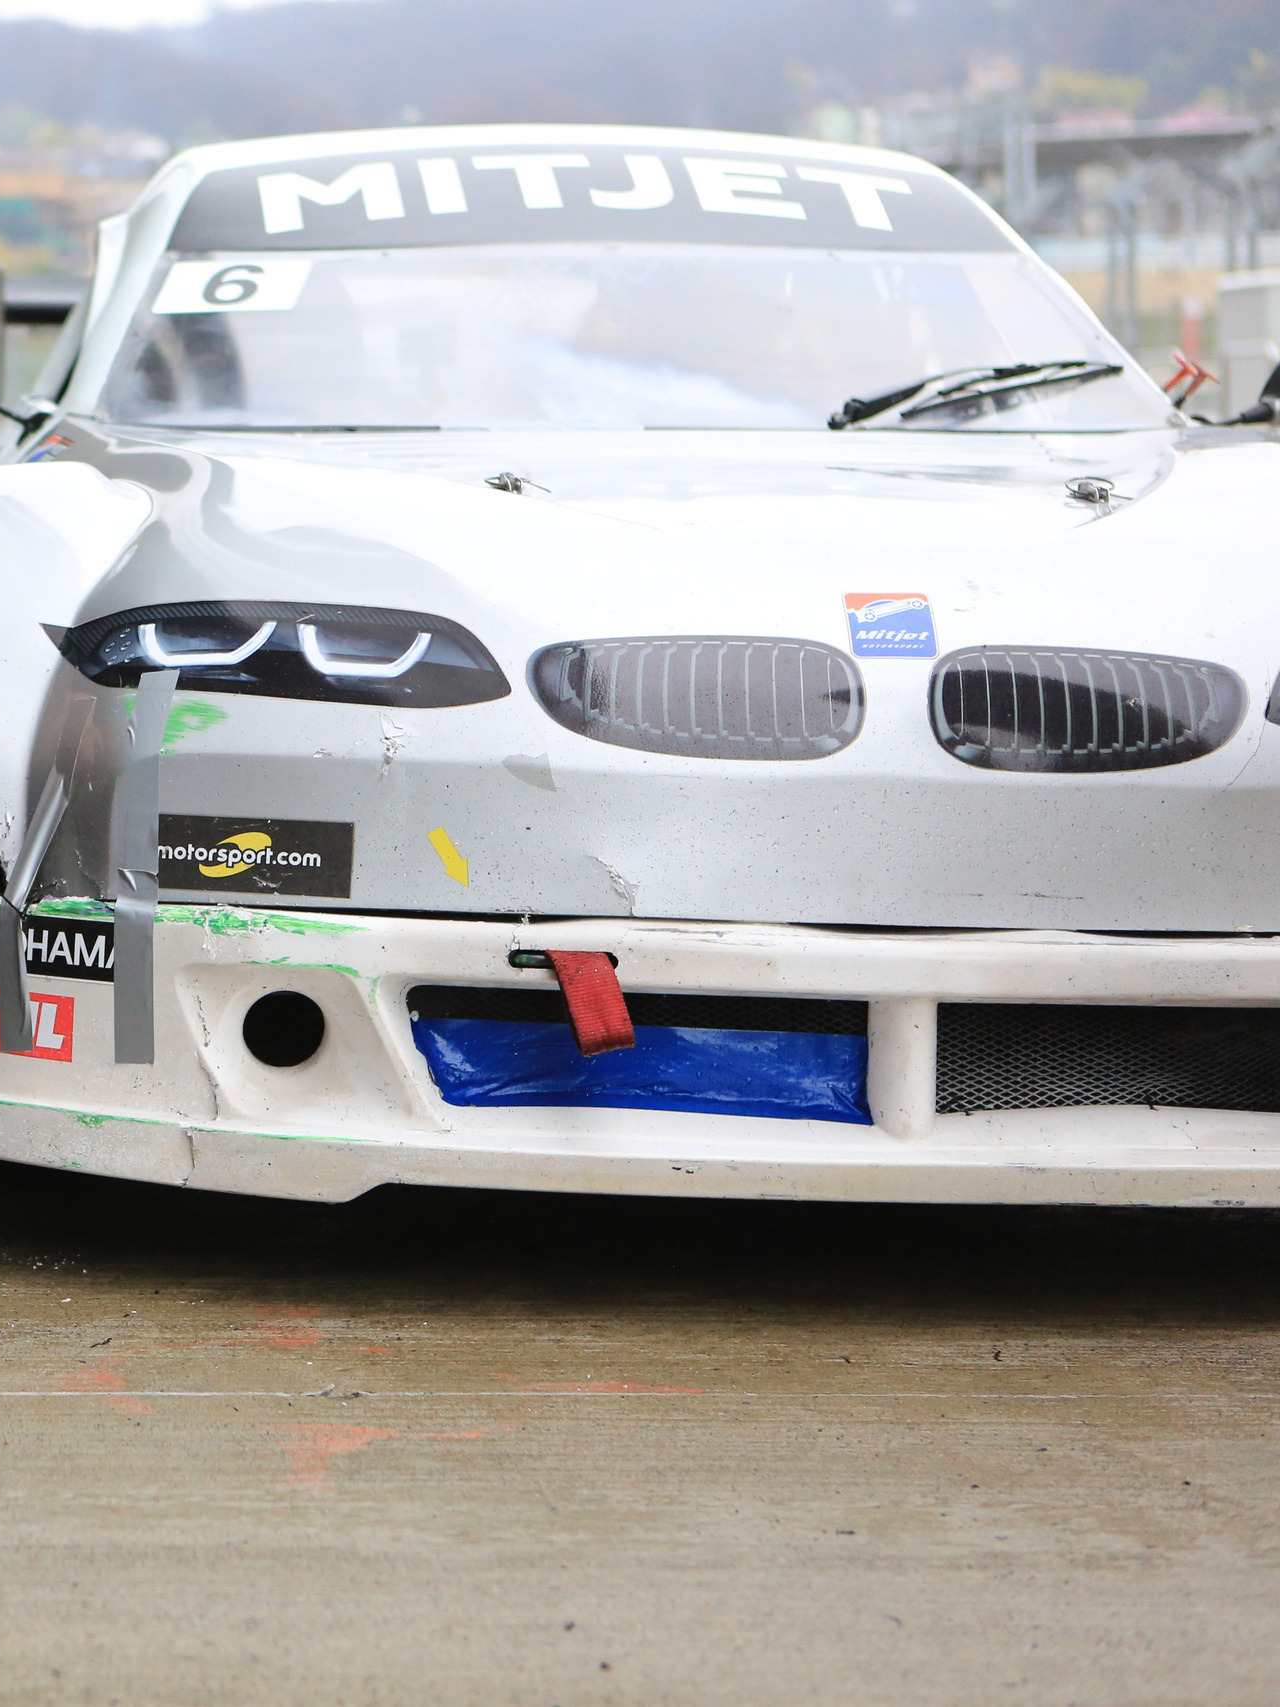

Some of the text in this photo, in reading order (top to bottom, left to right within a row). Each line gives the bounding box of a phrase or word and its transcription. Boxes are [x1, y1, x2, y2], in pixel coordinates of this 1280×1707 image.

[257, 154, 913, 234] MITJET
[202, 264, 261, 306] 6
[856, 629, 930, 642] Mitjet
[158, 843, 322, 867] motorsport.com
